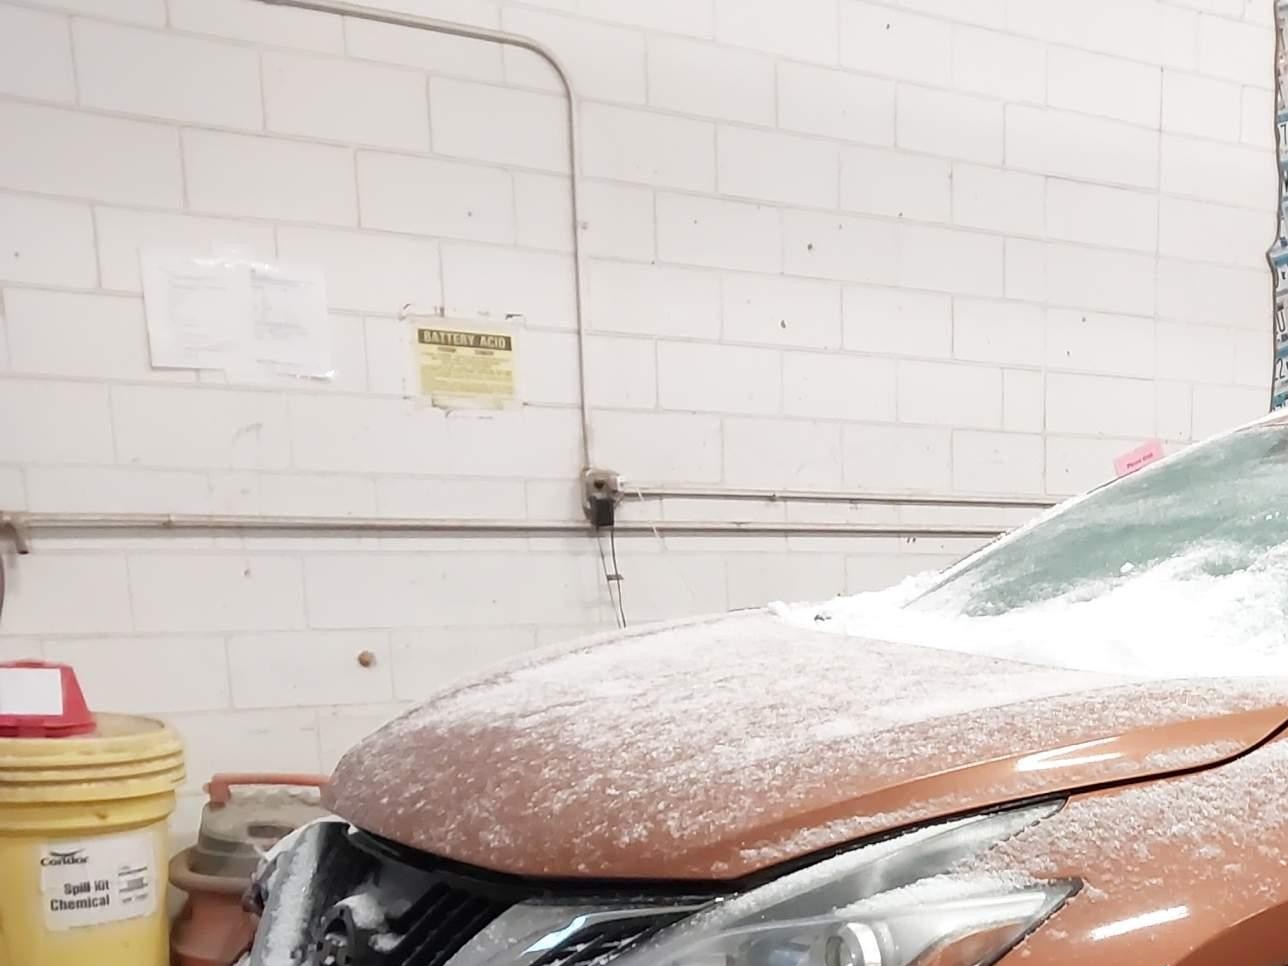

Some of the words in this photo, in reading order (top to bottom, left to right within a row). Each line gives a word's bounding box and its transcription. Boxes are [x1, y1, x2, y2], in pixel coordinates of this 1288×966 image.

[423, 330, 475, 347] BATTERY
[479, 335, 506, 350] ACID
[64, 880, 91, 897] Spill
[94, 879, 110, 892] Kit
[50, 894, 110, 913] Chemical
